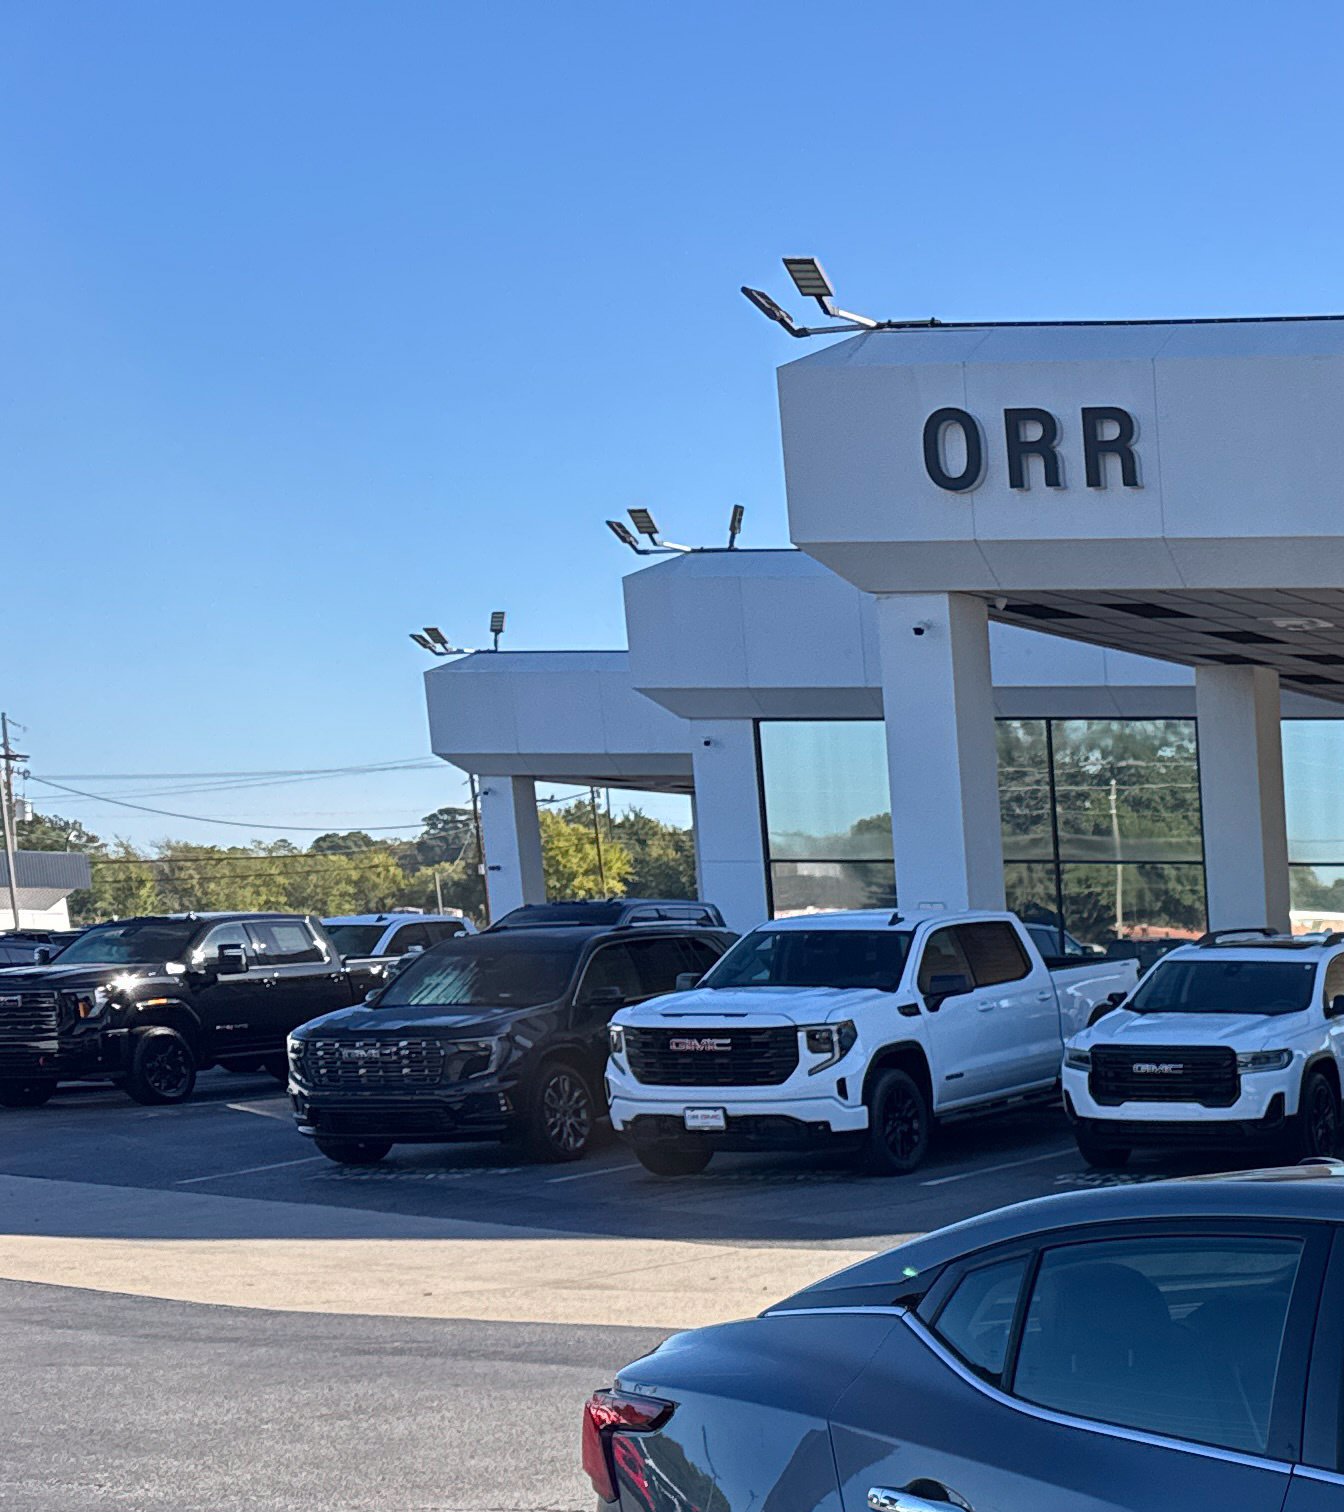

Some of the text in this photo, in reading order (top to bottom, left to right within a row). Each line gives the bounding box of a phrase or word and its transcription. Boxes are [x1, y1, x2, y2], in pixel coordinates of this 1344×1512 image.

[923, 406, 1142, 492] ORR
[670, 1038, 731, 1051] GMC
[1132, 1063, 1183, 1074] GMC
